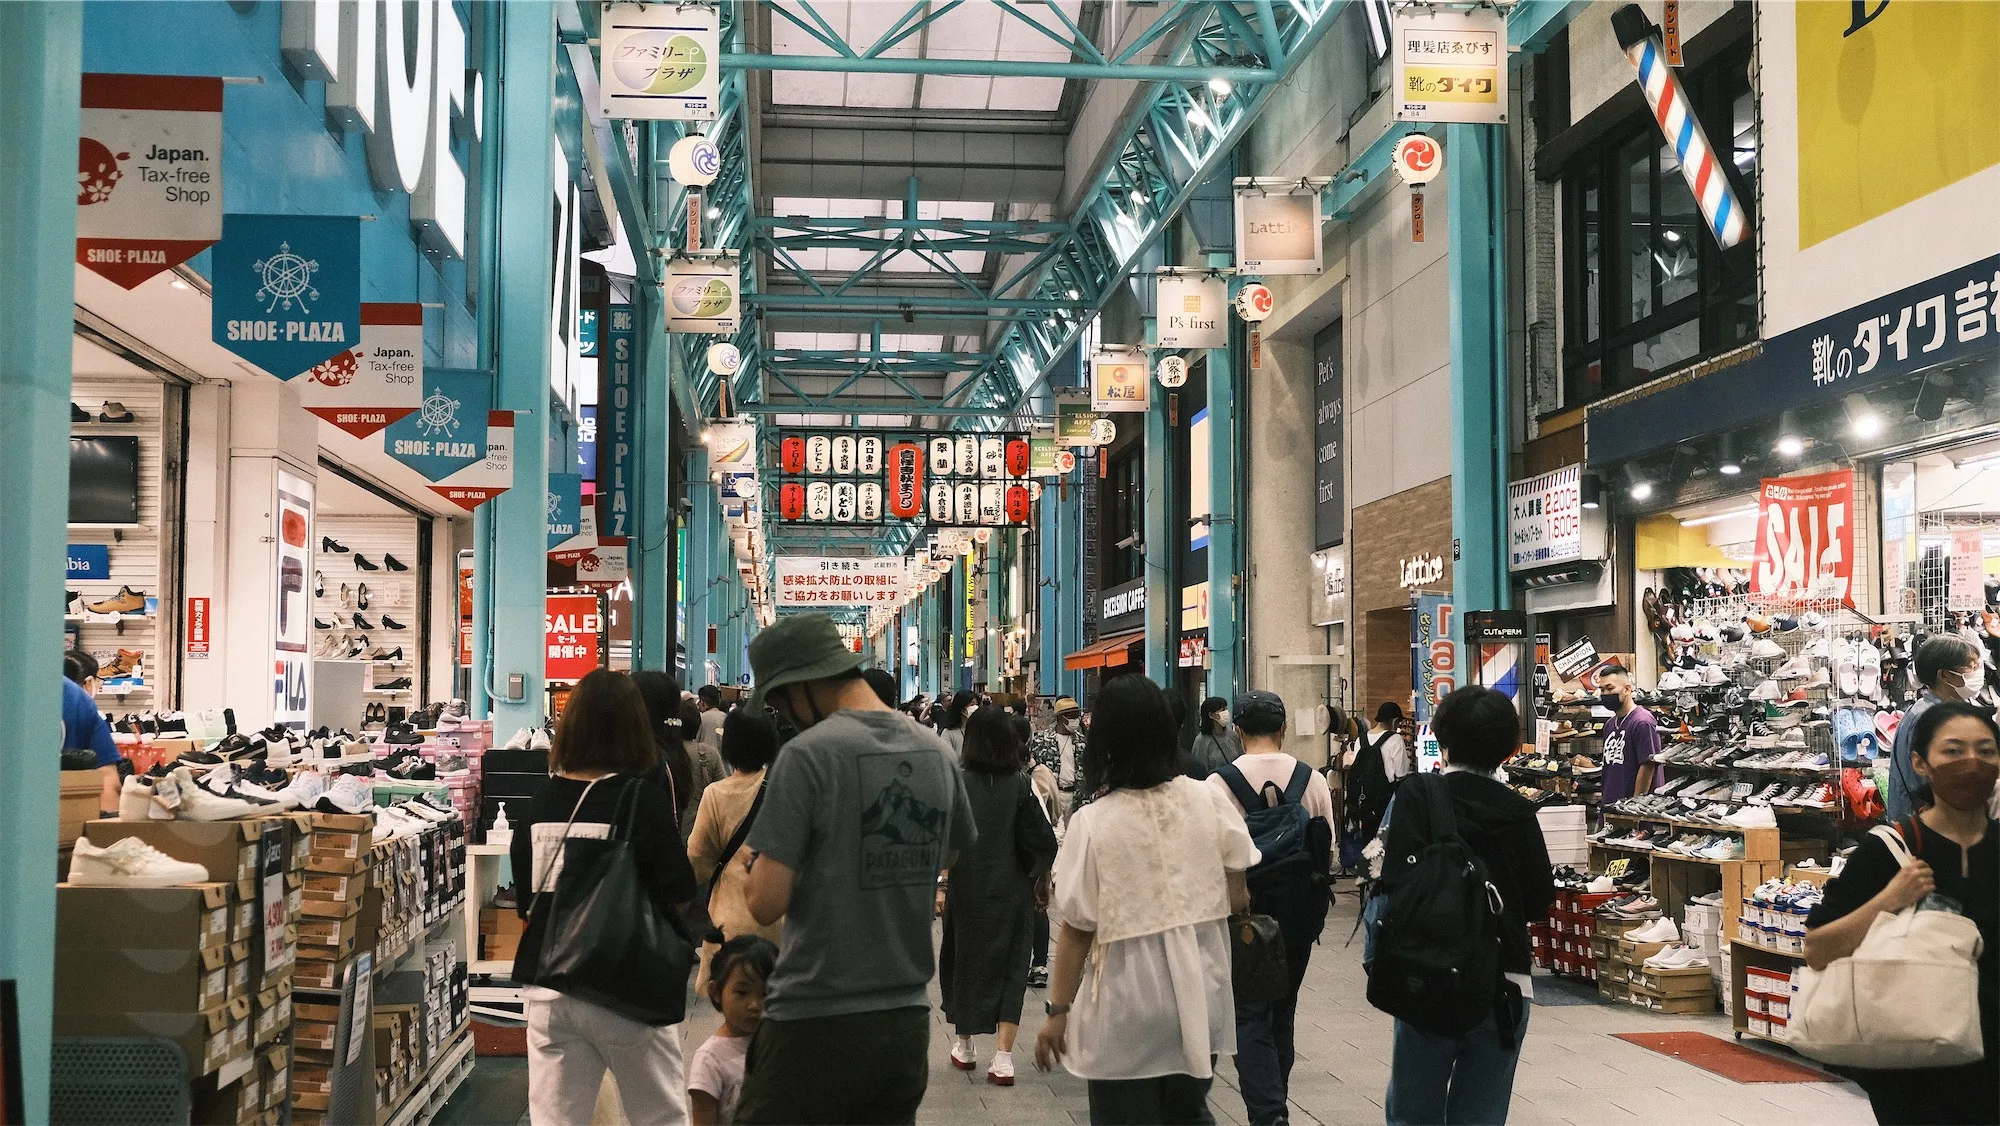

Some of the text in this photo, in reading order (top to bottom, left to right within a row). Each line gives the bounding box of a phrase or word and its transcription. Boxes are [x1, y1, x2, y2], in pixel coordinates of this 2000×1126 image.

[623, 46, 684, 59] ファミリー
[1407, 39, 1493, 56] 理髪店ゑびす
[643, 66, 696, 81] プラザ
[1408, 76, 1492, 94] 靴のダイワ
[145, 144, 209, 164] Japan.
[138, 166, 210, 184] Tax-free
[165, 186, 210, 206] Shop
[678, 286, 718, 295] ファミリー
[692, 299, 726, 308] プラザ
[613, 312, 632, 331] 靴
[1811, 294, 1946, 388] 靴のダイワ
[373, 346, 414, 360] Japan.
[368, 360, 415, 372] Tax-free
[1317, 356, 1335, 387] Pet's
[385, 373, 415, 386] Shop
[1106, 385, 1136, 398] 松屋
[1318, 396, 1342, 426] always
[1318, 440, 1337, 465] come
[485, 461, 508, 472] Shop
[1318, 479, 1335, 505] first
[1758, 502, 1849, 599] SALE
[820, 561, 860, 571] 引き続き
[1399, 552, 1445, 589] Lattice
[783, 574, 898, 586] 感染拡大防止の取組に
[783, 590, 898, 602] ご協力をお願いします
[546, 614, 598, 634] SALE
[557, 635, 577, 644] セール
[548, 645, 587, 658] 開催中
[1557, 645, 1593, 670] CHAMPION
[1534, 673, 1548, 687] STOP
[1423, 740, 1439, 757] 理
[1605, 860, 1625, 877] Sale
